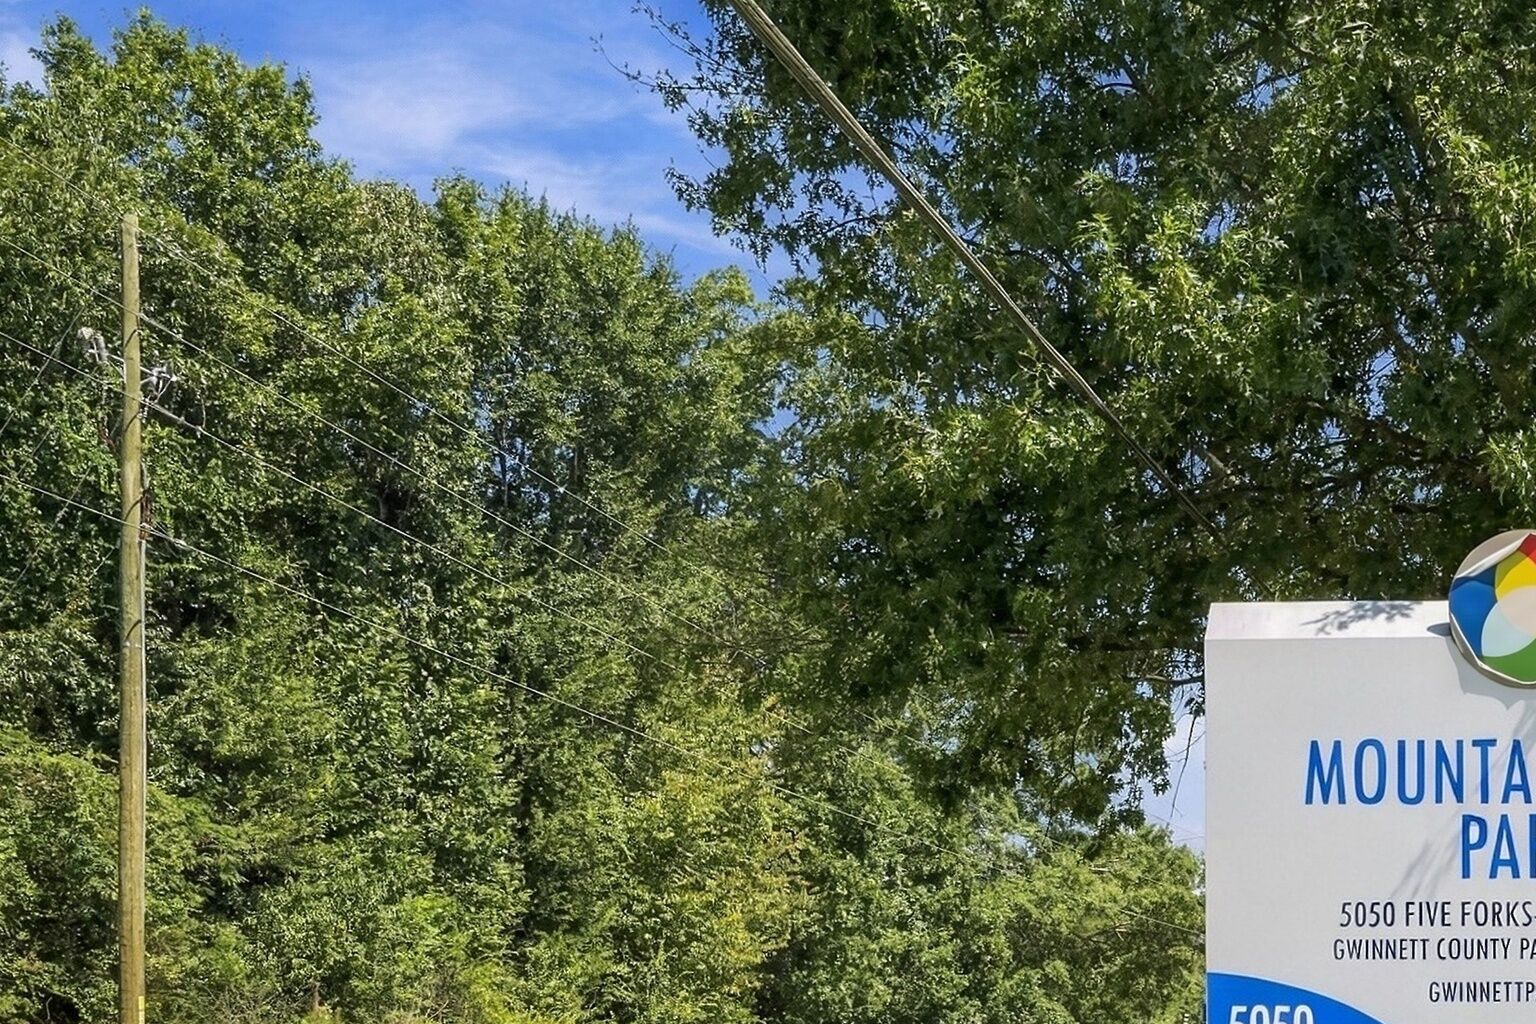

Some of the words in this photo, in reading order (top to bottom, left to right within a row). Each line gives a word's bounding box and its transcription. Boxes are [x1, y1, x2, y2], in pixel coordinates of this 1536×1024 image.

[1339, 902, 1396, 928] 5050
[1405, 901, 1452, 927] FIVE
[1333, 938, 1429, 961] GWINNETT
[1437, 938, 1511, 961] COUNTY
